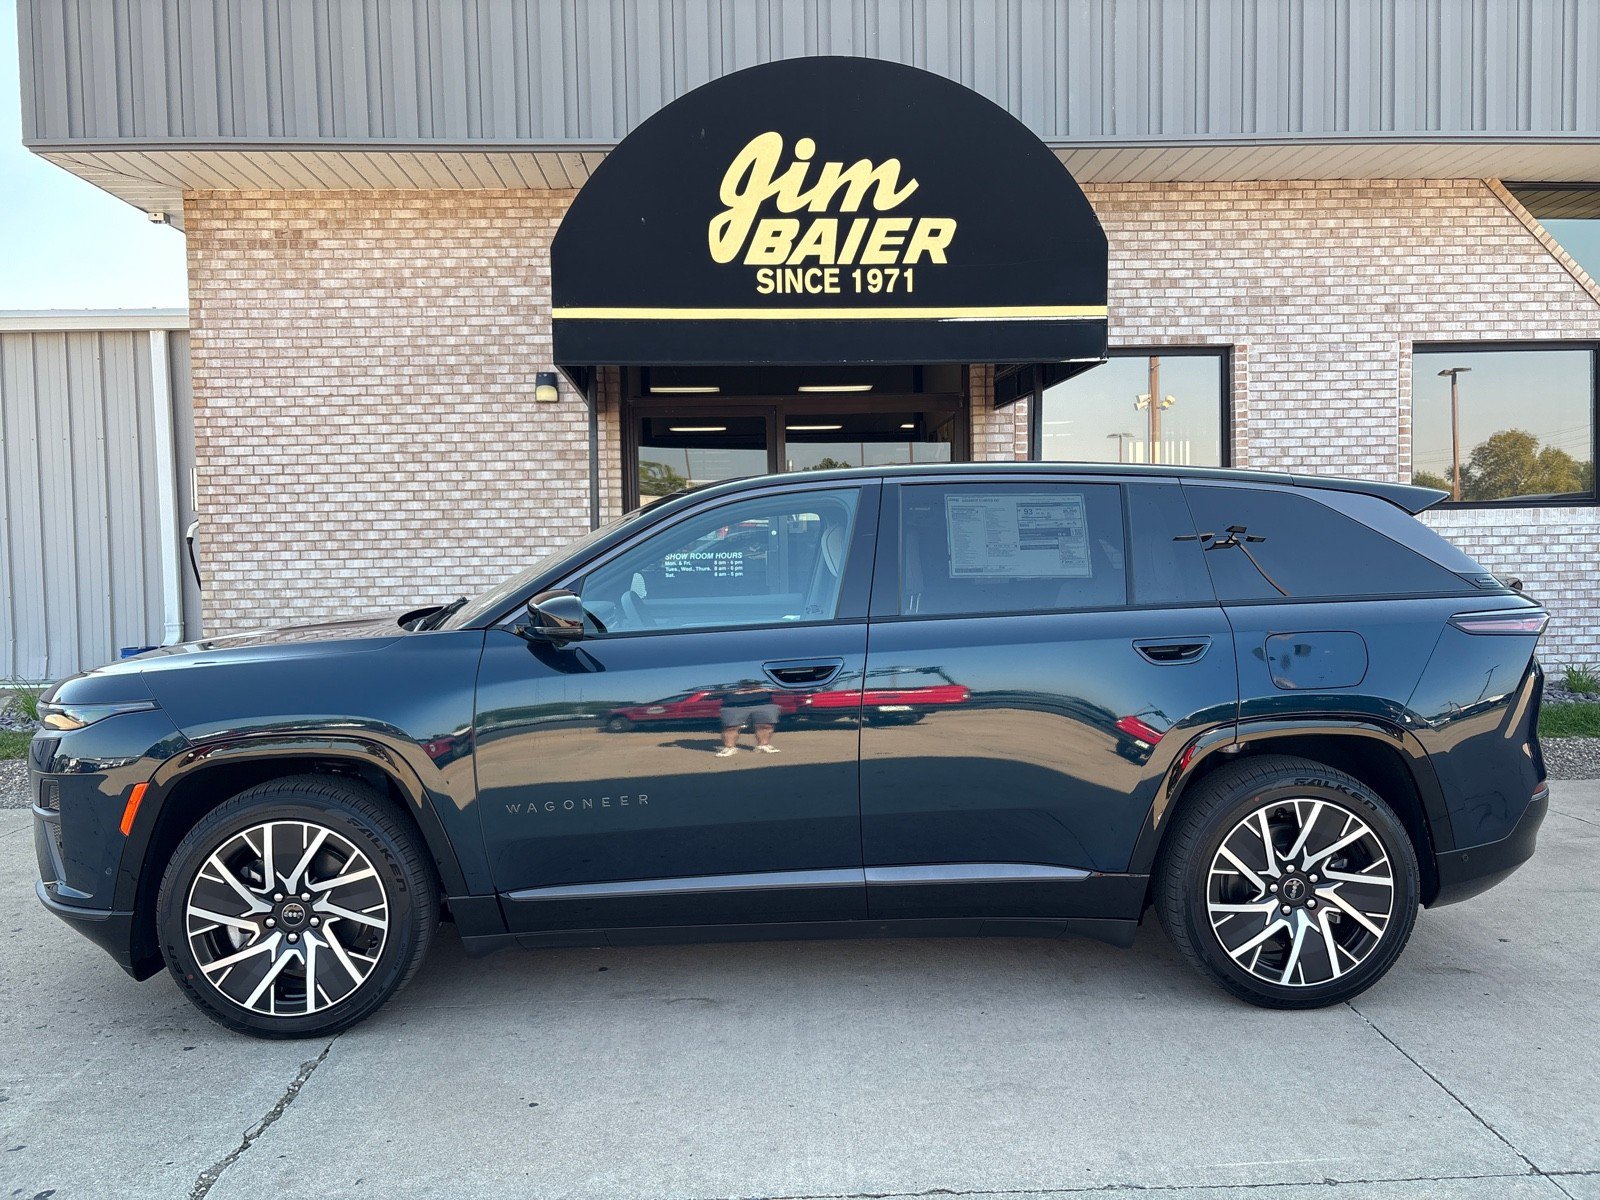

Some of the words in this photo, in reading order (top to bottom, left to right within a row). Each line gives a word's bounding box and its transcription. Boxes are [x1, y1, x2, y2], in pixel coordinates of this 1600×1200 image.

[708, 131, 920, 264] Jim
[743, 217, 958, 266] BAIER
[756, 268, 841, 294] SINCE
[852, 268, 913, 293] 1971
[505, 794, 649, 814] WAGONEER
[1293, 778, 1378, 811] FALKEN
[346, 816, 408, 893] FALKEN
